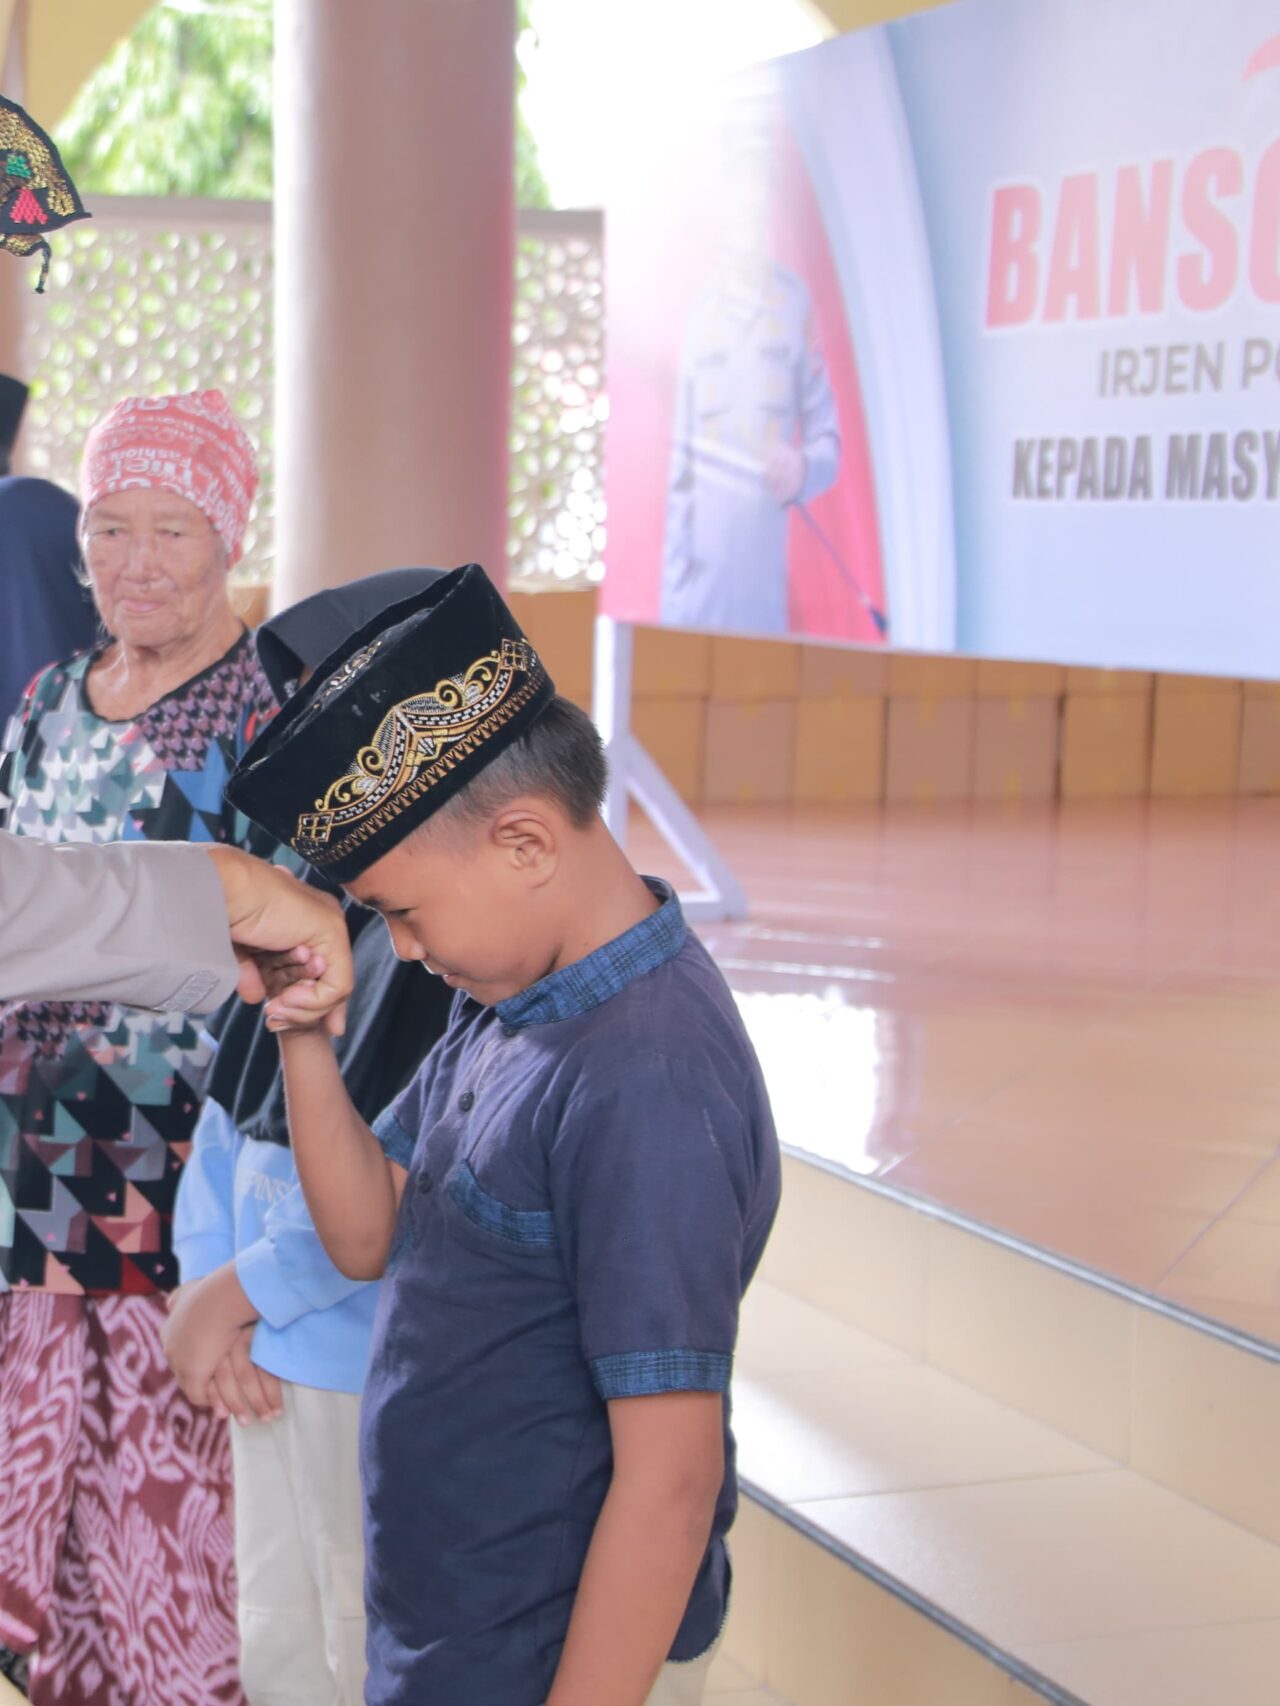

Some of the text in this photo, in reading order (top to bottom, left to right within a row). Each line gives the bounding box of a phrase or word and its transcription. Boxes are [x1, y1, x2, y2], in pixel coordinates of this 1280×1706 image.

[1098, 336, 1280, 399] IRJEN P
[1011, 435, 1153, 501] KEPADA
